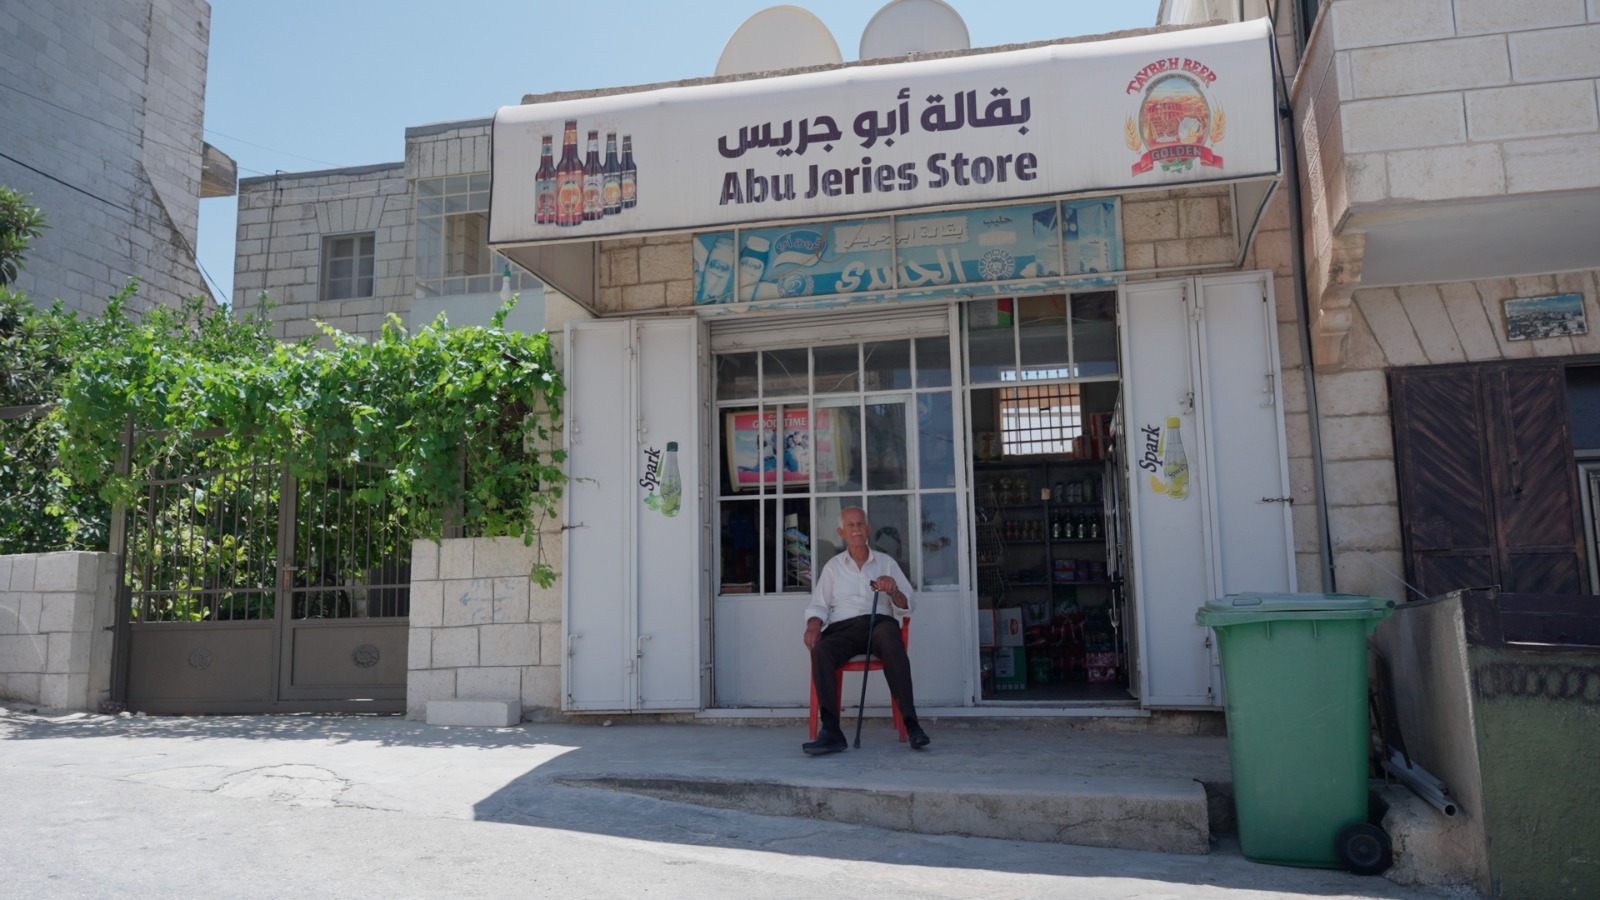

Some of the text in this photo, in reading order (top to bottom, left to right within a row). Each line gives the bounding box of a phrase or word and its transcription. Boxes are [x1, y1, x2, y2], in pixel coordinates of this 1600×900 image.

[1126, 57, 1180, 95] TAYBEH
[1181, 58, 1217, 89] BEER
[717, 87, 1031, 159] بقالة أبو جريس
[1151, 146, 1202, 161] GOLDEN
[719, 151, 1037, 206] Abu Jeries Store
[784, 417, 807, 427] TIME
[639, 447, 660, 491] Spark
[1138, 423, 1163, 473] Spark
